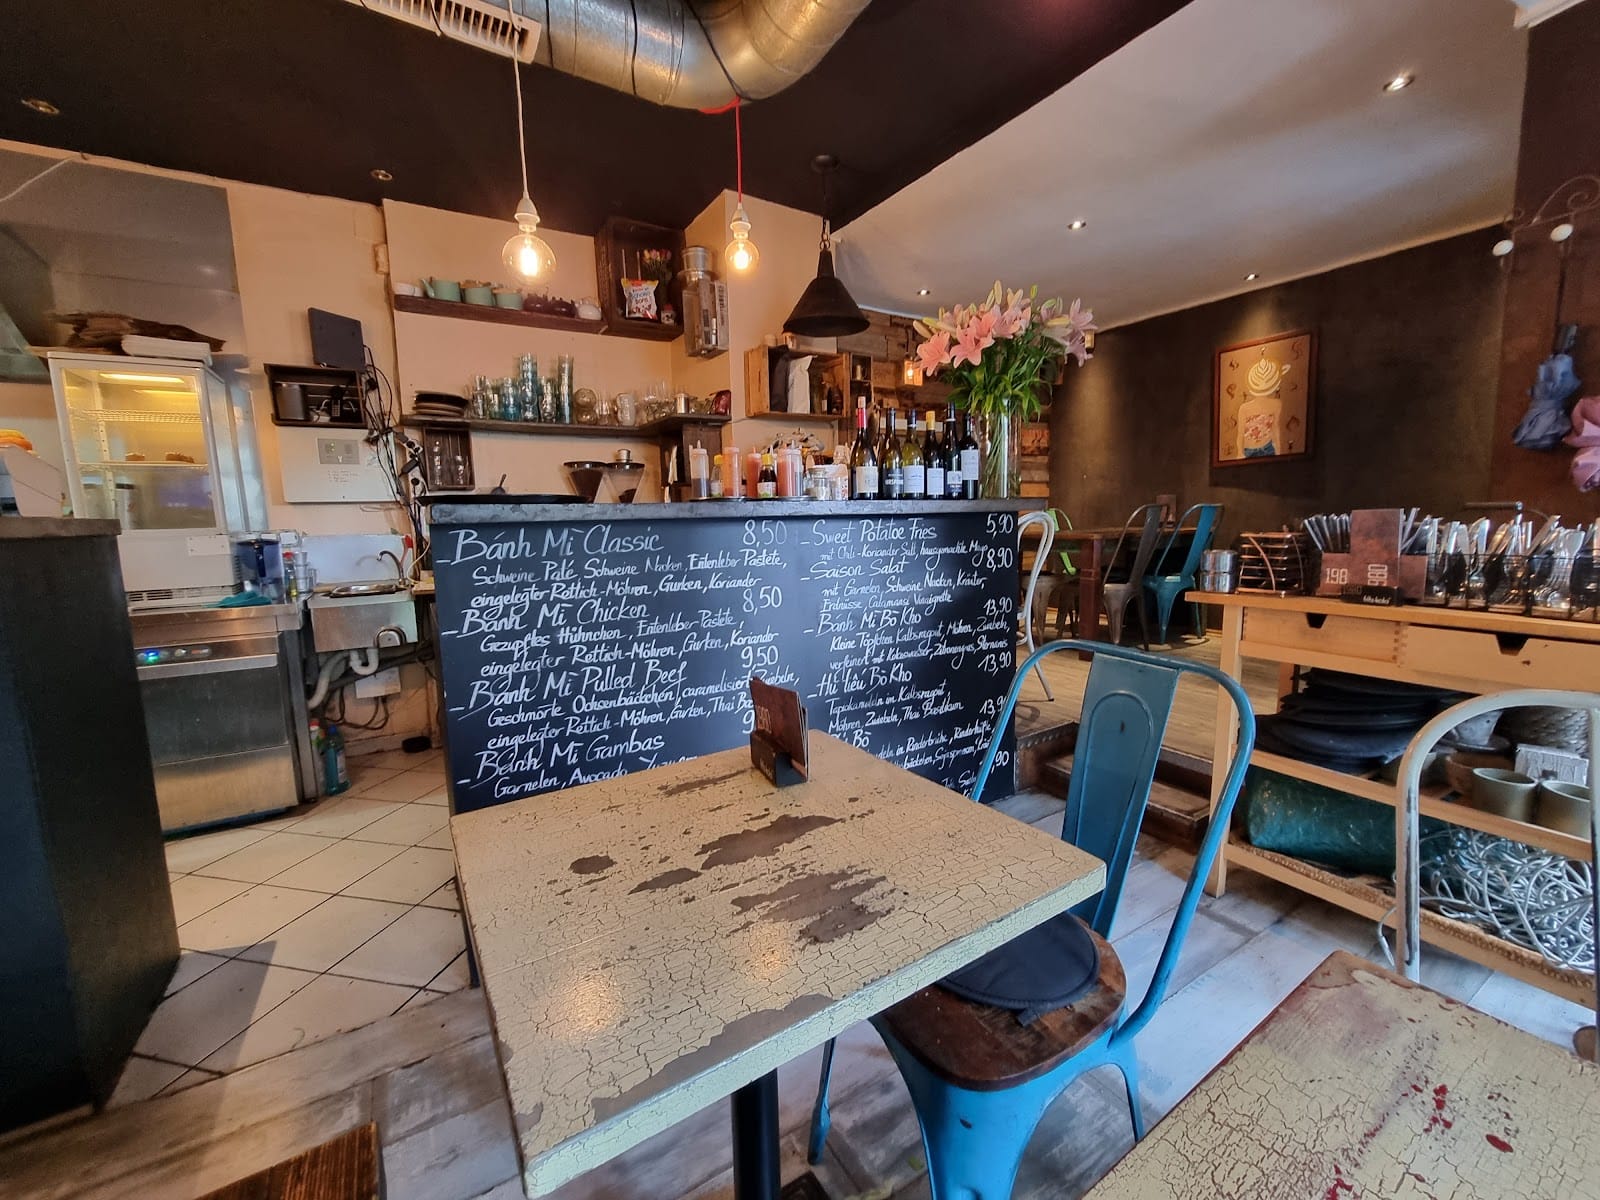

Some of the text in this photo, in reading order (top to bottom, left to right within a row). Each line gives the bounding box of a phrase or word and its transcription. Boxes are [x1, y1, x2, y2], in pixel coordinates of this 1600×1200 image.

[583, 523, 665, 555] Classic
[742, 519, 788, 548] 8,50
[811, 519, 856, 546] Sweet
[907, 517, 938, 541] Fries
[985, 512, 1014, 540] 5,90
[472, 563, 541, 586] Schweine
[583, 557, 641, 579] Schweine
[738, 548, 787, 569] Pastete,
[810, 555, 911, 580] Saison Salat
[986, 546, 1014, 573] 8,90
[658, 573, 708, 594] Gurken,
[708, 571, 763, 590] Koriander
[1325, 567, 1349, 585] 198
[576, 595, 651, 625] Chicken
[742, 586, 783, 617] 8,50
[900, 605, 922, 626] Kho
[983, 596, 1013, 619] 13,90
[556, 624, 634, 645] Hühnchen,
[682, 631, 730, 652] Gurken,
[729, 624, 780, 648] Koriander
[741, 645, 779, 671] 9,50
[977, 650, 1012, 679] 13,90
[580, 661, 637, 695] Pulled
[643, 659, 688, 706] Beef
[888, 662, 913, 684] Kho
[708, 696, 736, 714] Thai
[742, 709, 756, 735] 9
[585, 728, 665, 762] Gambas
[494, 769, 567, 799] Garnelen,
